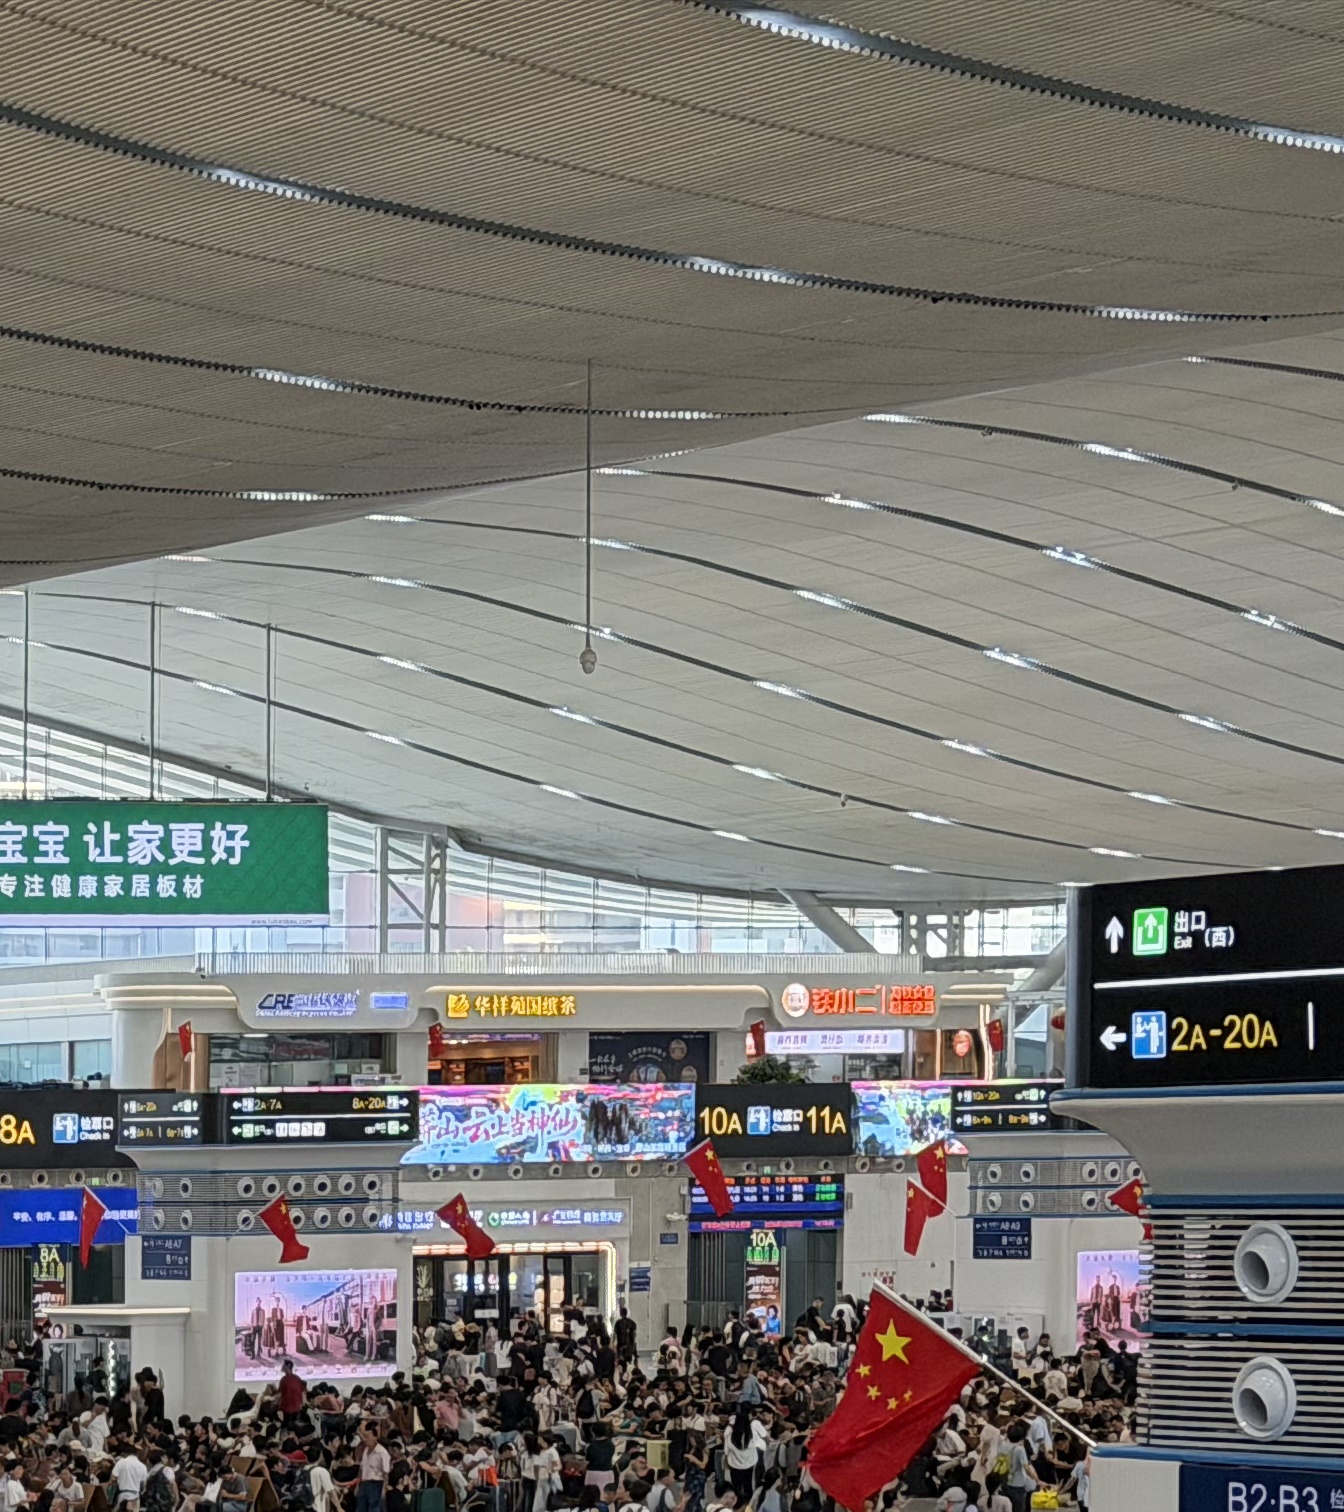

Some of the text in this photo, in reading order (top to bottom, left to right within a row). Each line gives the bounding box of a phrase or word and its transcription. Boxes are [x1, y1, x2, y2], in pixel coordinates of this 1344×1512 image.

[83, 821, 251, 867] 让家更好
[1174, 909, 1206, 933] 出口
[1174, 935, 1193, 949] Exit
[1171, 1013, 1278, 1051] 2A-20A
[699, 1106, 743, 1136] 10A
[806, 1106, 847, 1135] 11A
[749, 1232, 778, 1247] 10A
[40, 1247, 61, 1263] 8A
